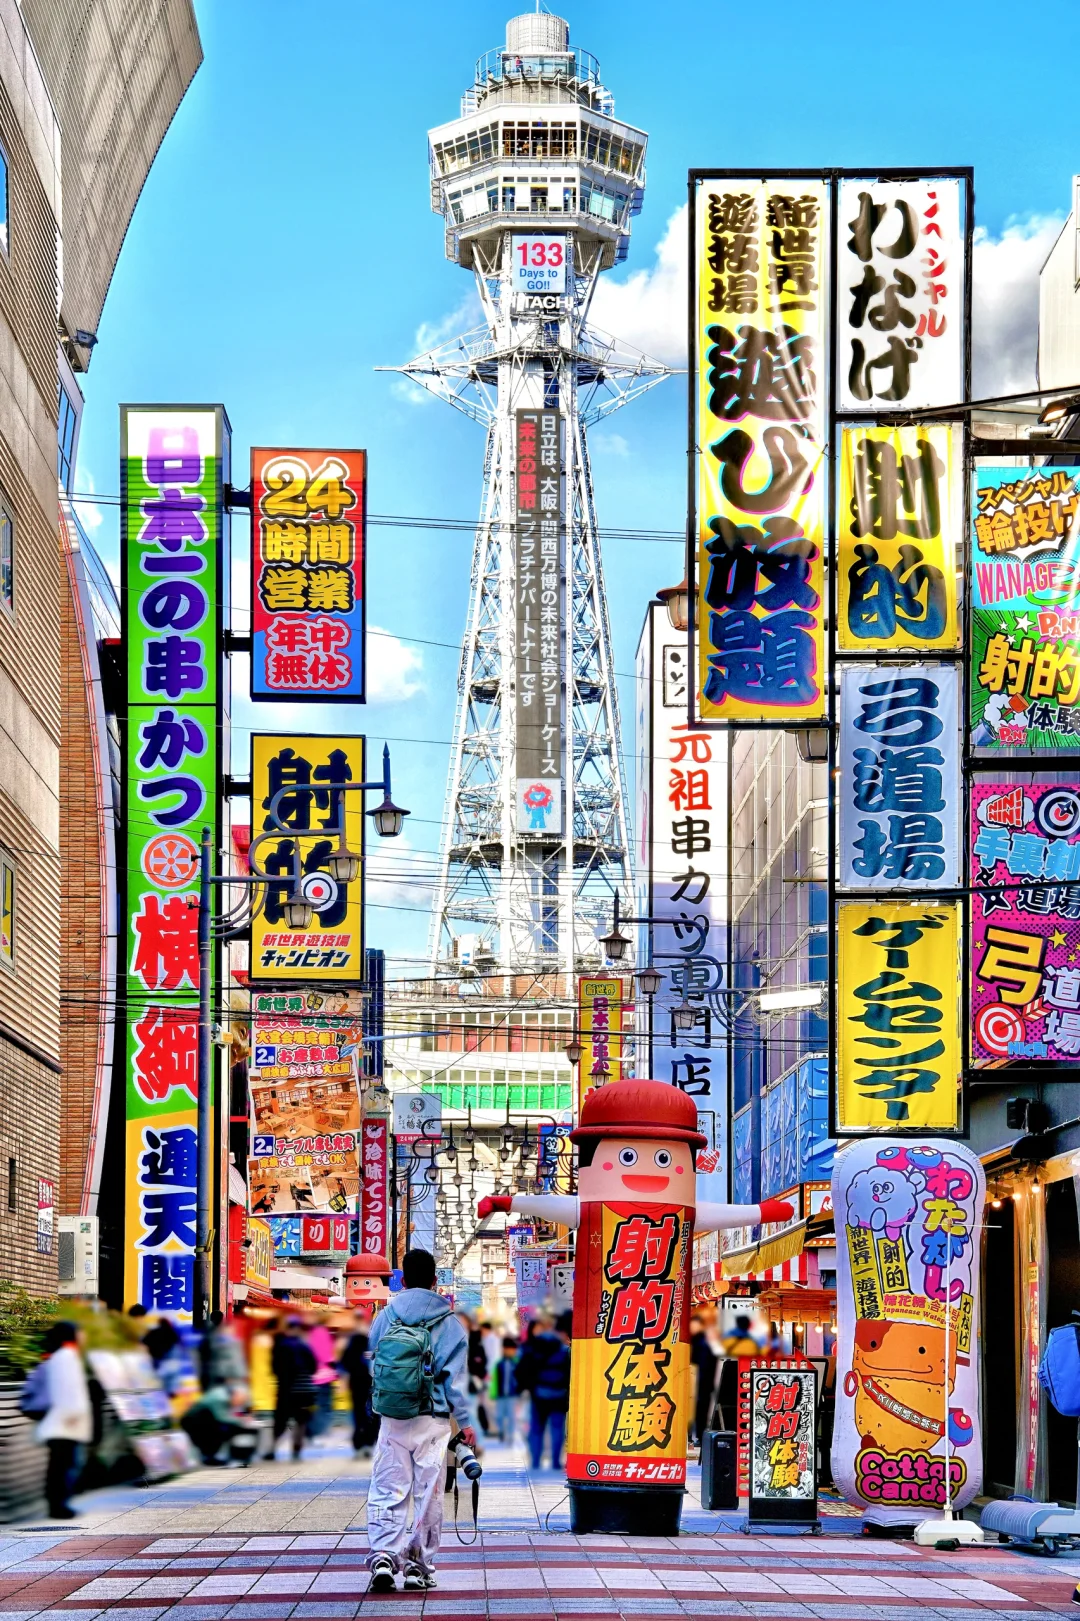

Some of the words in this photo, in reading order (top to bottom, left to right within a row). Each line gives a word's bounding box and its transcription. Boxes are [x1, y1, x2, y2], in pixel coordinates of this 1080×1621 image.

[517, 242, 564, 267] 133
[519, 268, 545, 279] Days
[548, 269, 558, 278] to
[707, 193, 759, 314] 遊技場
[527, 280, 550, 290] GO!!
[847, 191, 923, 401] わなげ
[261, 457, 356, 520] 24
[977, 471, 1073, 509] スペシャル
[703, 324, 820, 706] 遊び放題
[262, 521, 355, 567] 時間
[518, 414, 537, 707] 「未来の都市」プラチナパートナーです
[847, 438, 948, 640] 射的
[260, 568, 354, 612] 営業
[541, 415, 558, 775] 日立は、大阪・関西万博の未来社会ショーケース
[975, 562, 1059, 605] WANAGE
[138, 426, 209, 828] 日本一の串かつ
[266, 619, 351, 654] 年中
[1038, 612, 1080, 637] PAN
[266, 652, 351, 690] 無休
[978, 633, 1080, 705] 射的
[999, 727, 1027, 743] PAN!
[1027, 701, 1080, 736] 体験
[851, 677, 947, 881] 弓道場
[988, 788, 1021, 812] NIN!
[262, 748, 352, 928] 射的
[988, 808, 1021, 826] NIN!
[260, 949, 351, 968] チャンピオン
[261, 934, 351, 947] 新世界遊技場
[978, 928, 1044, 1006] 弓
[257, 996, 303, 1012] 新世界
[848, 914, 950, 1120] ゲームセンター
[1041, 965, 1080, 1054] 道場
[1007, 1041, 1048, 1057] NICE!
[276, 1135, 354, 1154] テーブル席も充実
[364, 1142, 384, 1254] 珍味てっちり
[921, 1161, 973, 1302] わたがし
[849, 1227, 882, 1320] 新世界一遊技場
[882, 1240, 905, 1288] 射的
[596, 1291, 610, 1334] しゃてき
[960, 1298, 972, 1347] わなげ
[624, 1462, 683, 1480] チャンピオン
[860, 1452, 962, 1481] Cotton
[860, 1475, 955, 1504] Candy
